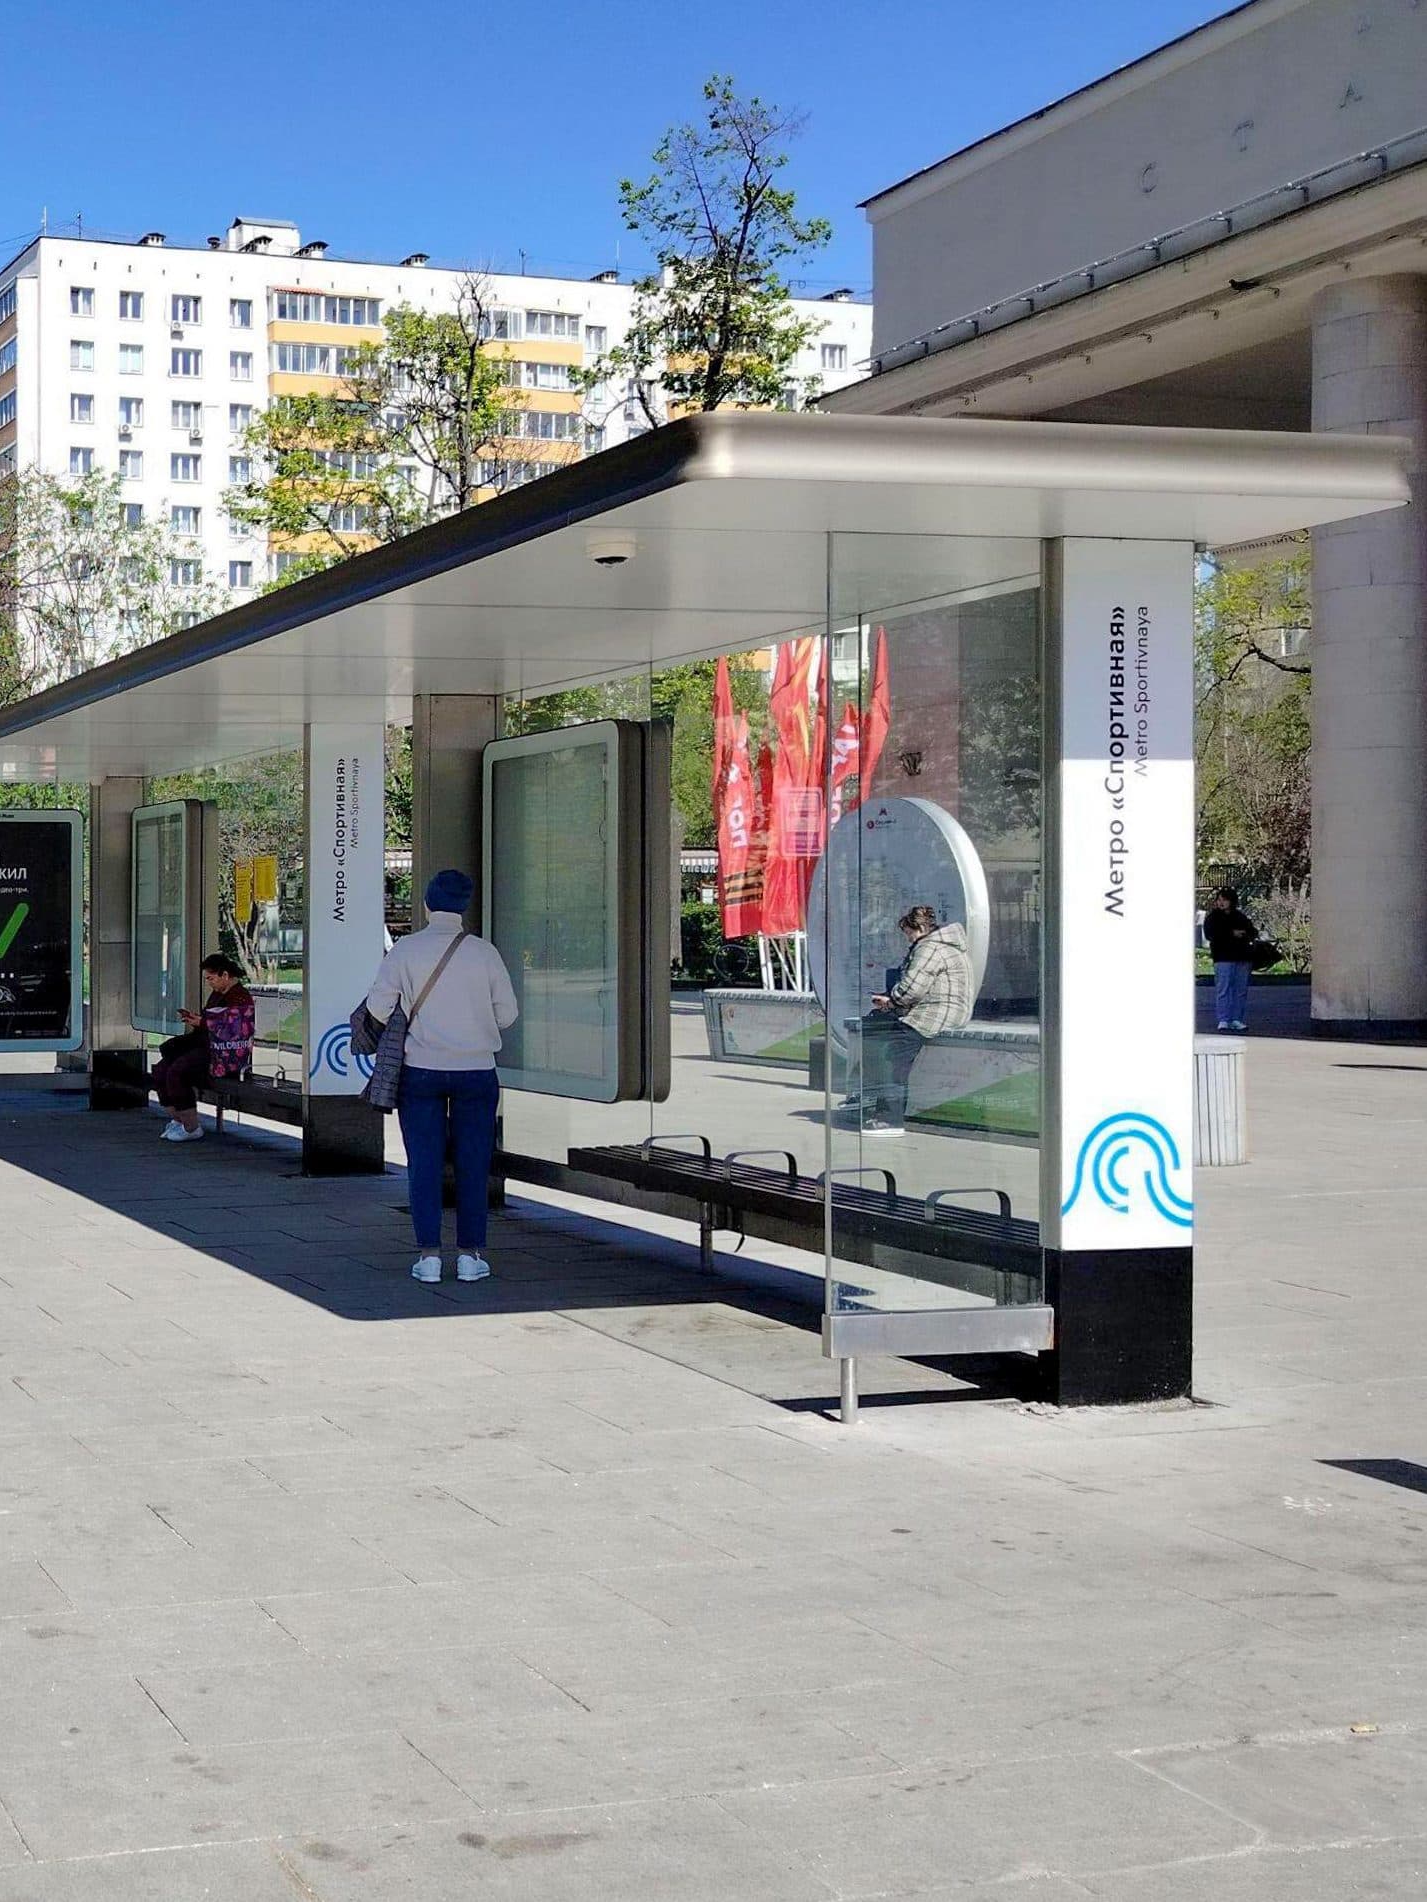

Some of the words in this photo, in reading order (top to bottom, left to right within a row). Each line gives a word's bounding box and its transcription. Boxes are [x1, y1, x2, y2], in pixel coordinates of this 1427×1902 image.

[1105, 606, 1129, 810] «Спортивная»
[1134, 606, 1151, 714] Sportivnaya
[1134, 720, 1148, 777] Metro
[333, 758, 347, 867] «Спортивная»
[350, 817, 359, 849] Metro
[333, 870, 347, 922] Метро
[1105, 820, 1129, 916] Метро
